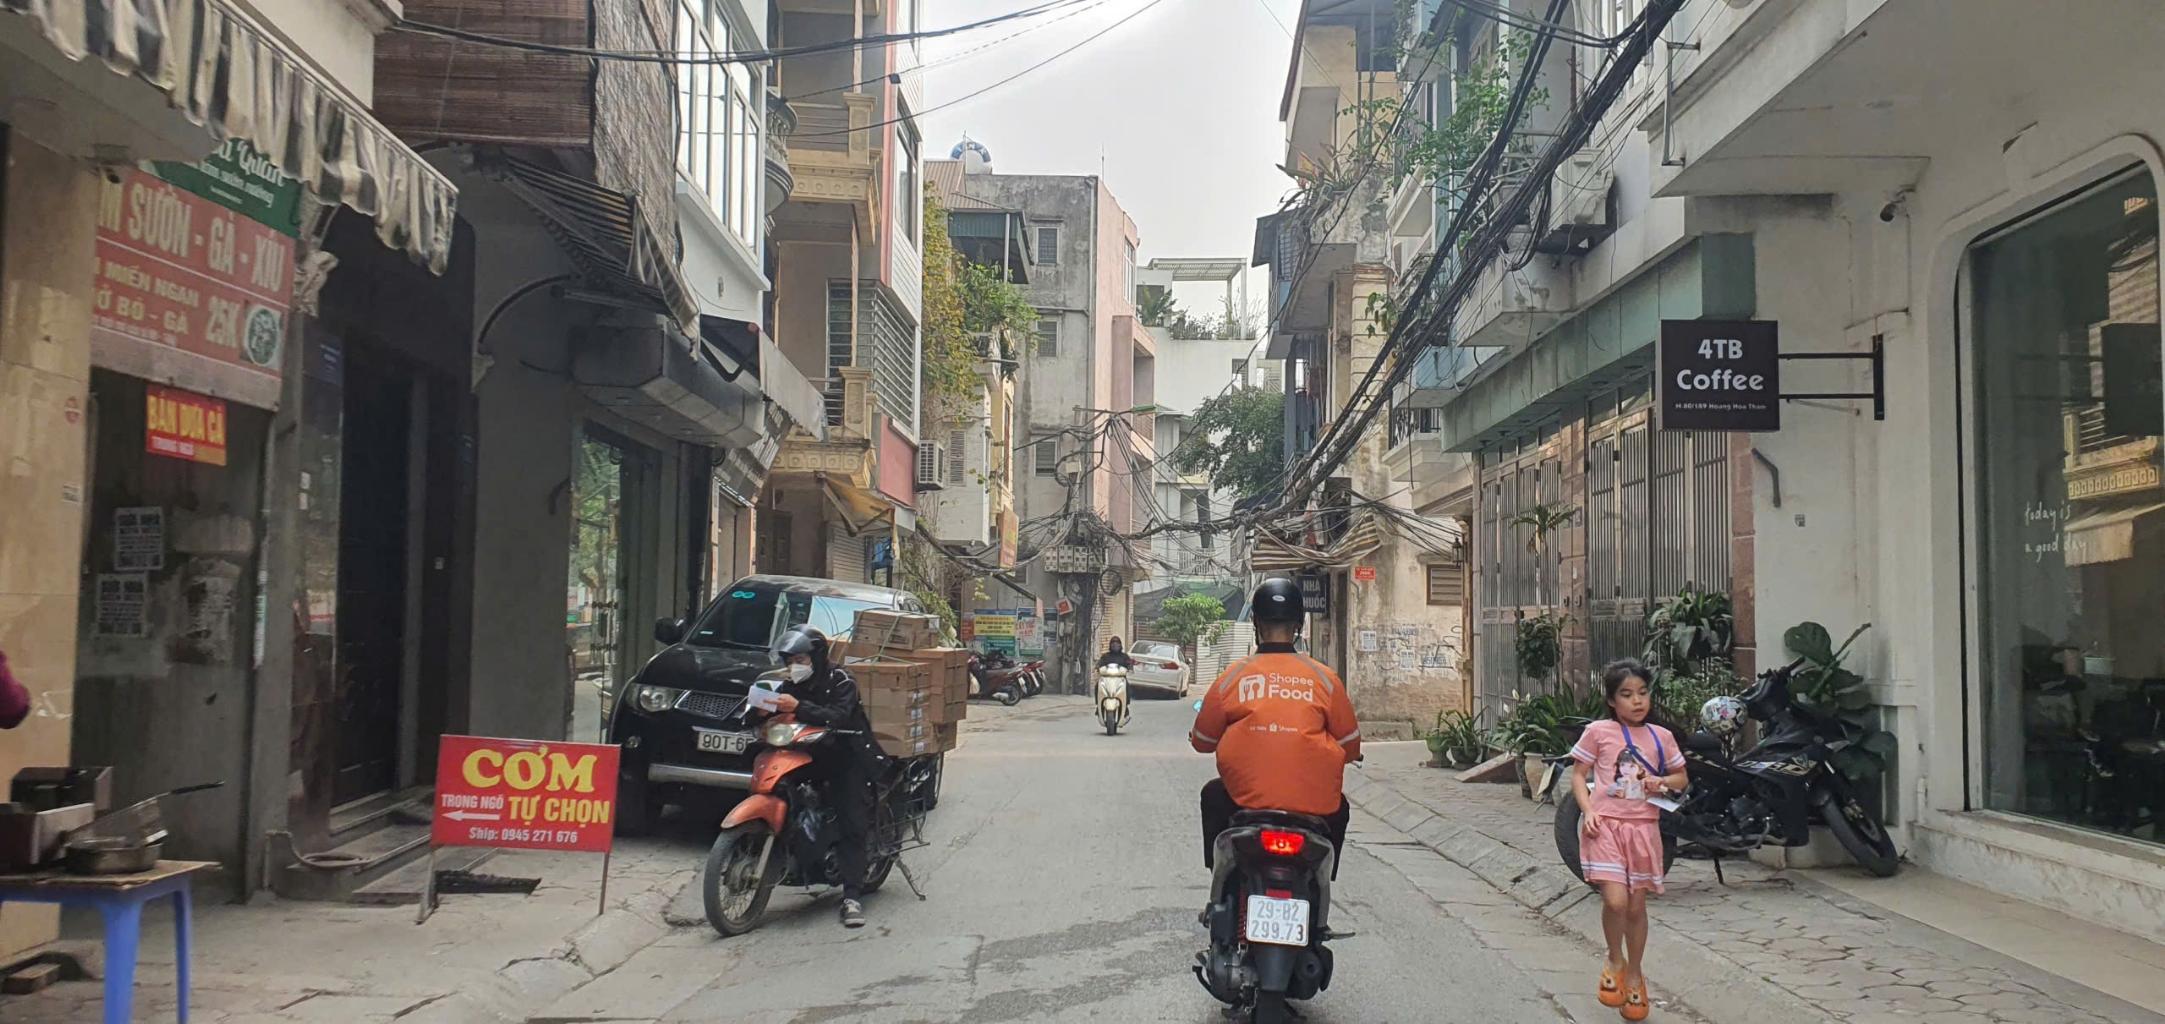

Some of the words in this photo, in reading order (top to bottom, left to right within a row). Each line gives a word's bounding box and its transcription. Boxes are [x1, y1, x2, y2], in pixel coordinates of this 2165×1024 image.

[127, 182, 192, 258] SƯỜN
[208, 210, 236, 275] GÀ
[153, 276, 199, 308] NGAN
[163, 310, 189, 336] GÀ
[205, 295, 240, 349] 25K
[1698, 338, 1743, 359] 4TB
[1676, 368, 1764, 390] Coffee
[2025, 501, 2056, 531] today
[2060, 499, 2071, 520] is
[2035, 533, 2059, 563] good
[2063, 532, 2087, 563] day
[1268, 672, 1314, 687] Shopee
[1268, 684, 1313, 702] Food
[462, 744, 598, 793] CƠM
[441, 794, 478, 808] TRONG
[508, 795, 542, 826] TỰ
[544, 798, 610, 829] CHỌN
[469, 826, 498, 840] Ship:
[501, 828, 530, 842] 0945
[532, 830, 552, 843] 271
[556, 831, 578, 844] 676
[1257, 900, 1300, 921] 29-B2
[1250, 919, 1304, 942] 299.73
